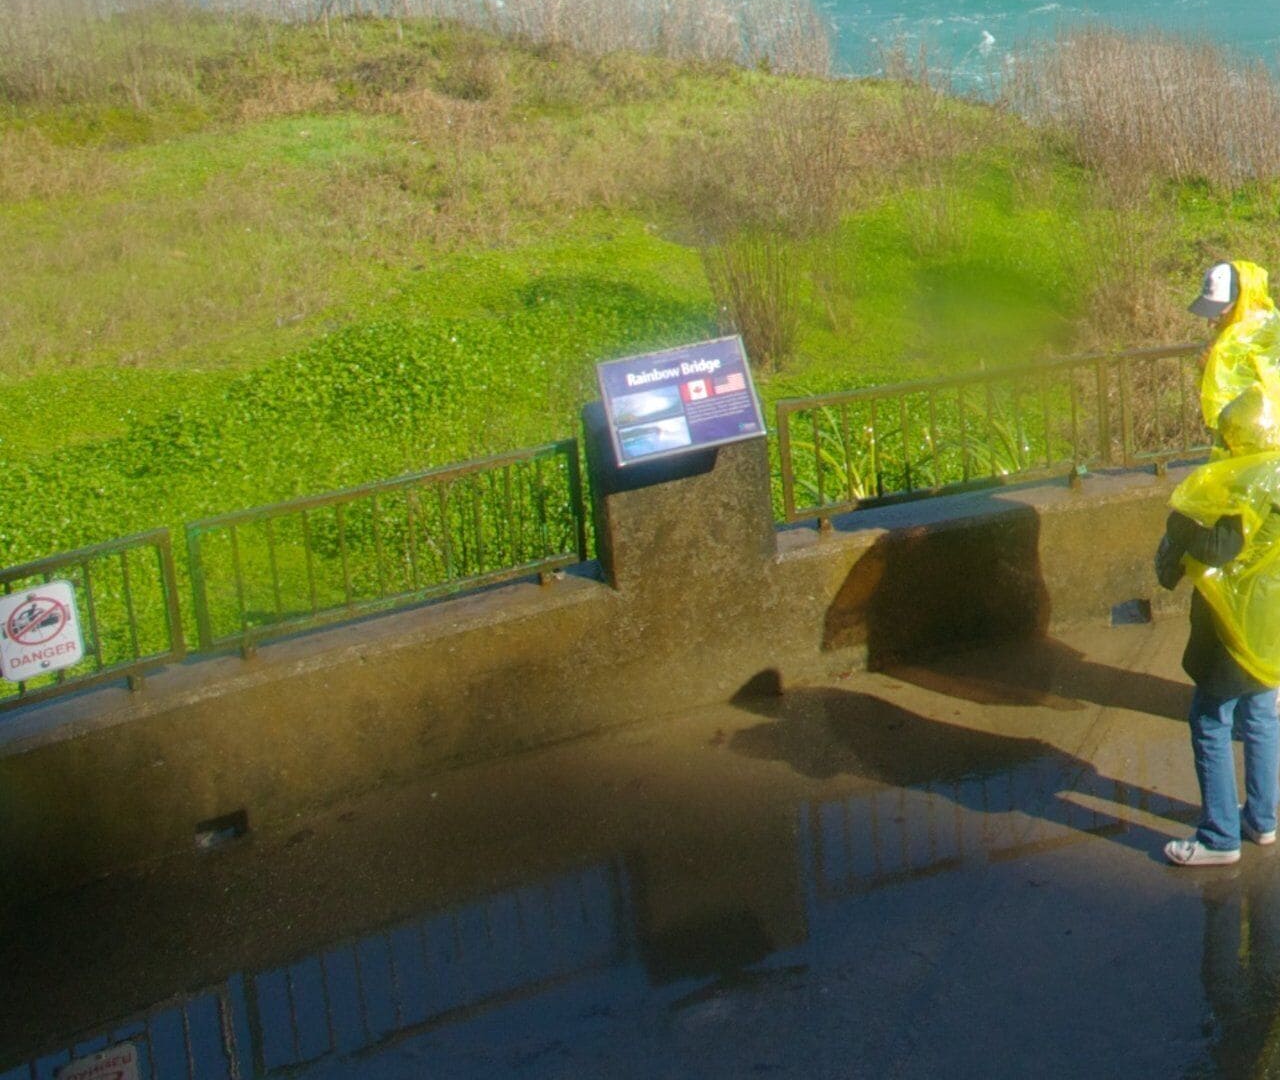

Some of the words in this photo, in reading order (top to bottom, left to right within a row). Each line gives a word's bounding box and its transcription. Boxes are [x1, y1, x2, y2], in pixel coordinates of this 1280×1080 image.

[626, 367, 680, 387] Rainbow
[681, 358, 721, 374] Bridge
[9, 641, 76, 668] DANGER
